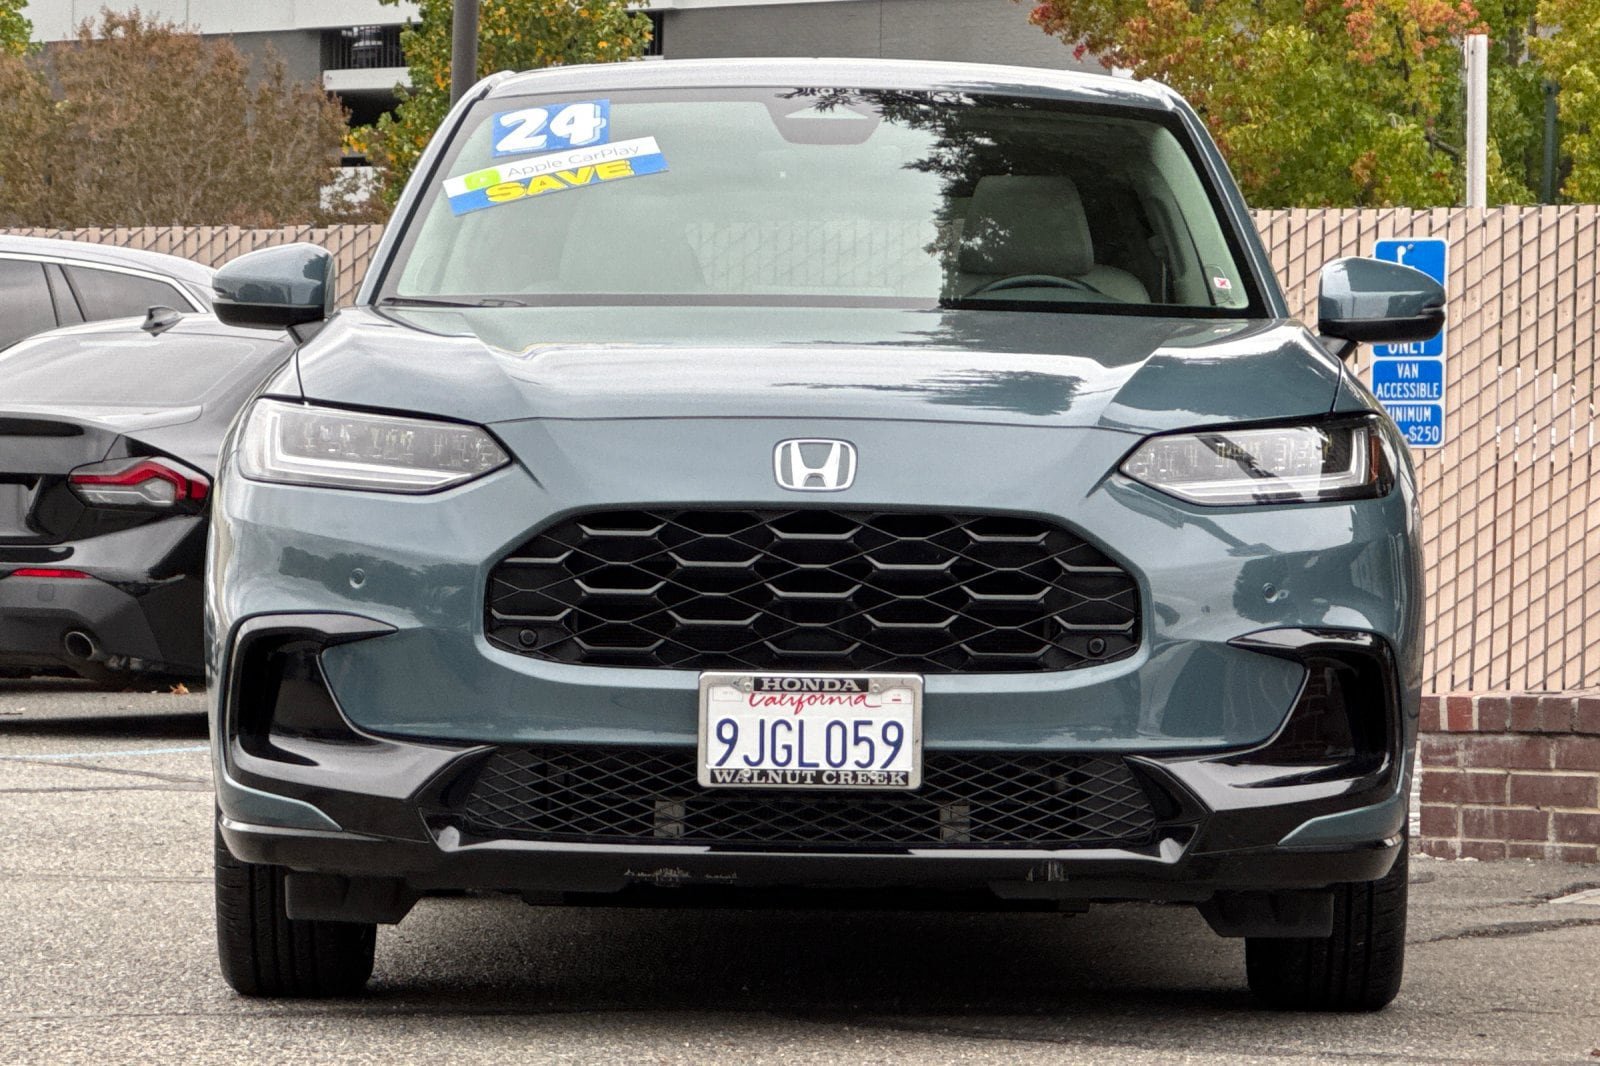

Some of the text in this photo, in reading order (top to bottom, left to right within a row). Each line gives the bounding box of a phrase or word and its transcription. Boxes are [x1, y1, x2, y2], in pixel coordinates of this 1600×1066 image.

[496, 103, 607, 152] 24
[508, 146, 640, 177] Apple CarPlay
[486, 160, 635, 202] SAVE
[1397, 363, 1419, 379] VAN
[1376, 382, 1440, 398] ACCESSIBLE
[1408, 425, 1440, 442] $250
[761, 678, 862, 692] HONDA
[715, 718, 905, 769] 9JGL059
[713, 769, 907, 786] WALNUT CREEK
